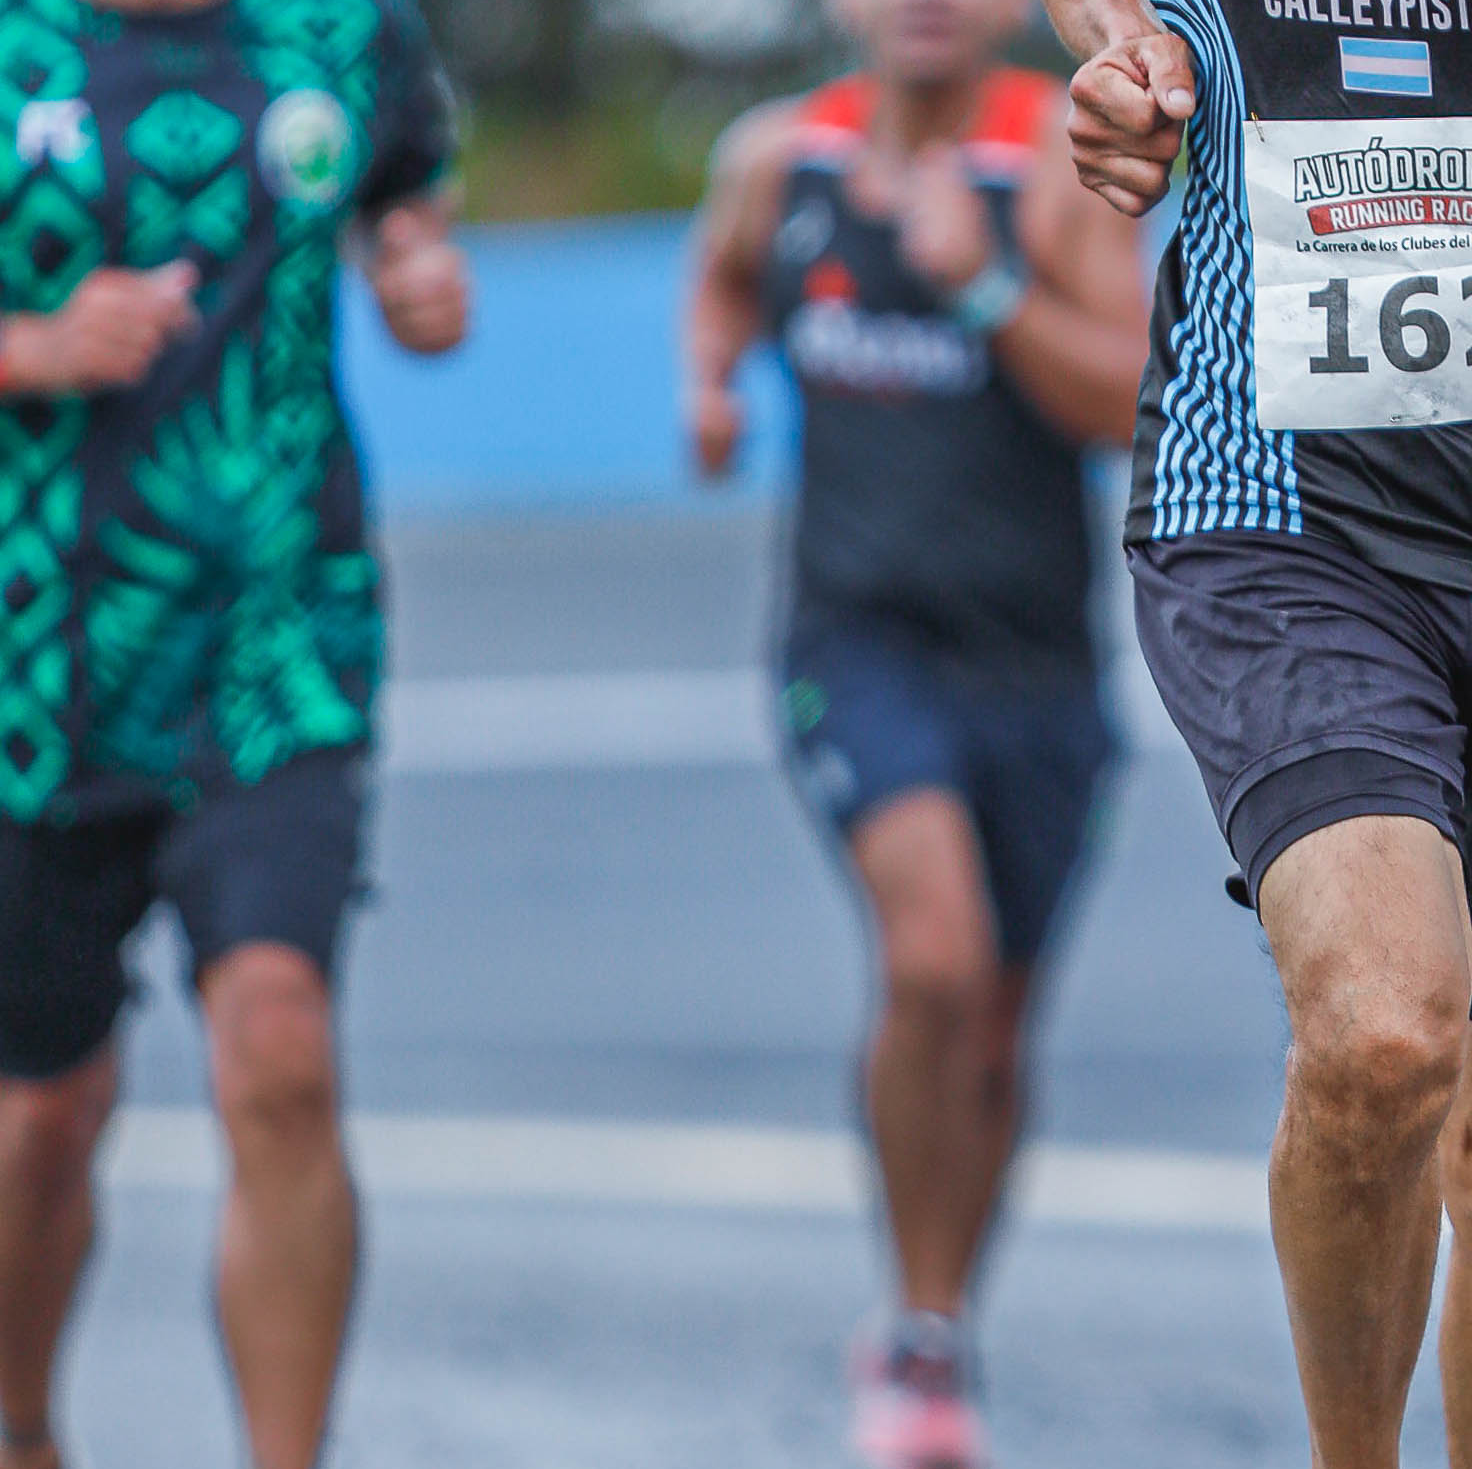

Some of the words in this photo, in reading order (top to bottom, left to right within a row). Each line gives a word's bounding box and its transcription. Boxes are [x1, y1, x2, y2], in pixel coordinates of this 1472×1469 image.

[1329, 198, 1425, 231] RUNNING
[1296, 239, 1310, 252] La
[1313, 239, 1358, 252] Carrera
[1361, 237, 1376, 251] de
[1380, 237, 1398, 251] los
[1402, 236, 1446, 250] Clubes
[1449, 235, 1470, 248] del
